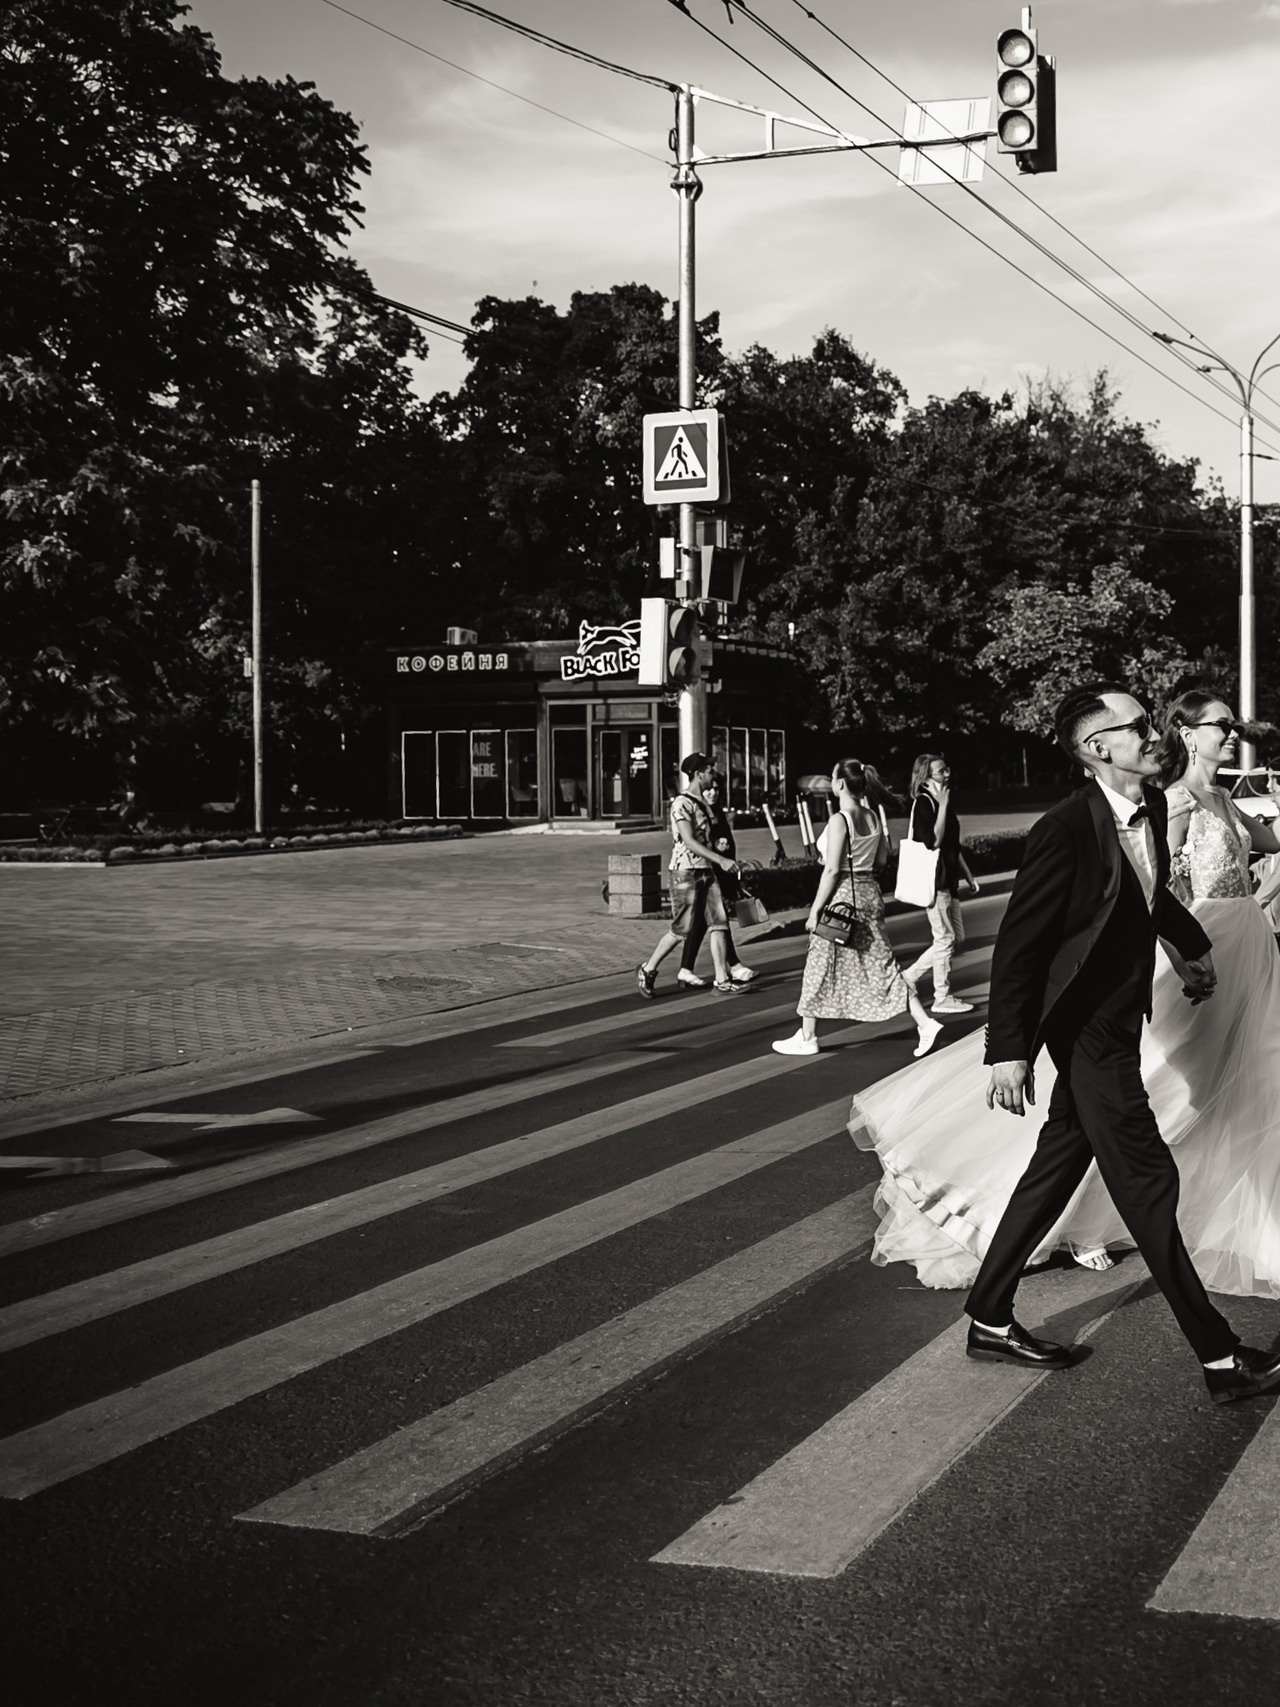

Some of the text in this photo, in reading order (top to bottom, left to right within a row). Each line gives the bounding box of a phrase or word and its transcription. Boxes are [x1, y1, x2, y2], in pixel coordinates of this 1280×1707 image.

[396, 651, 508, 673] КОФЕЙНЯ
[560, 647, 641, 681] BLACK FO
[473, 741, 492, 757] ARE
